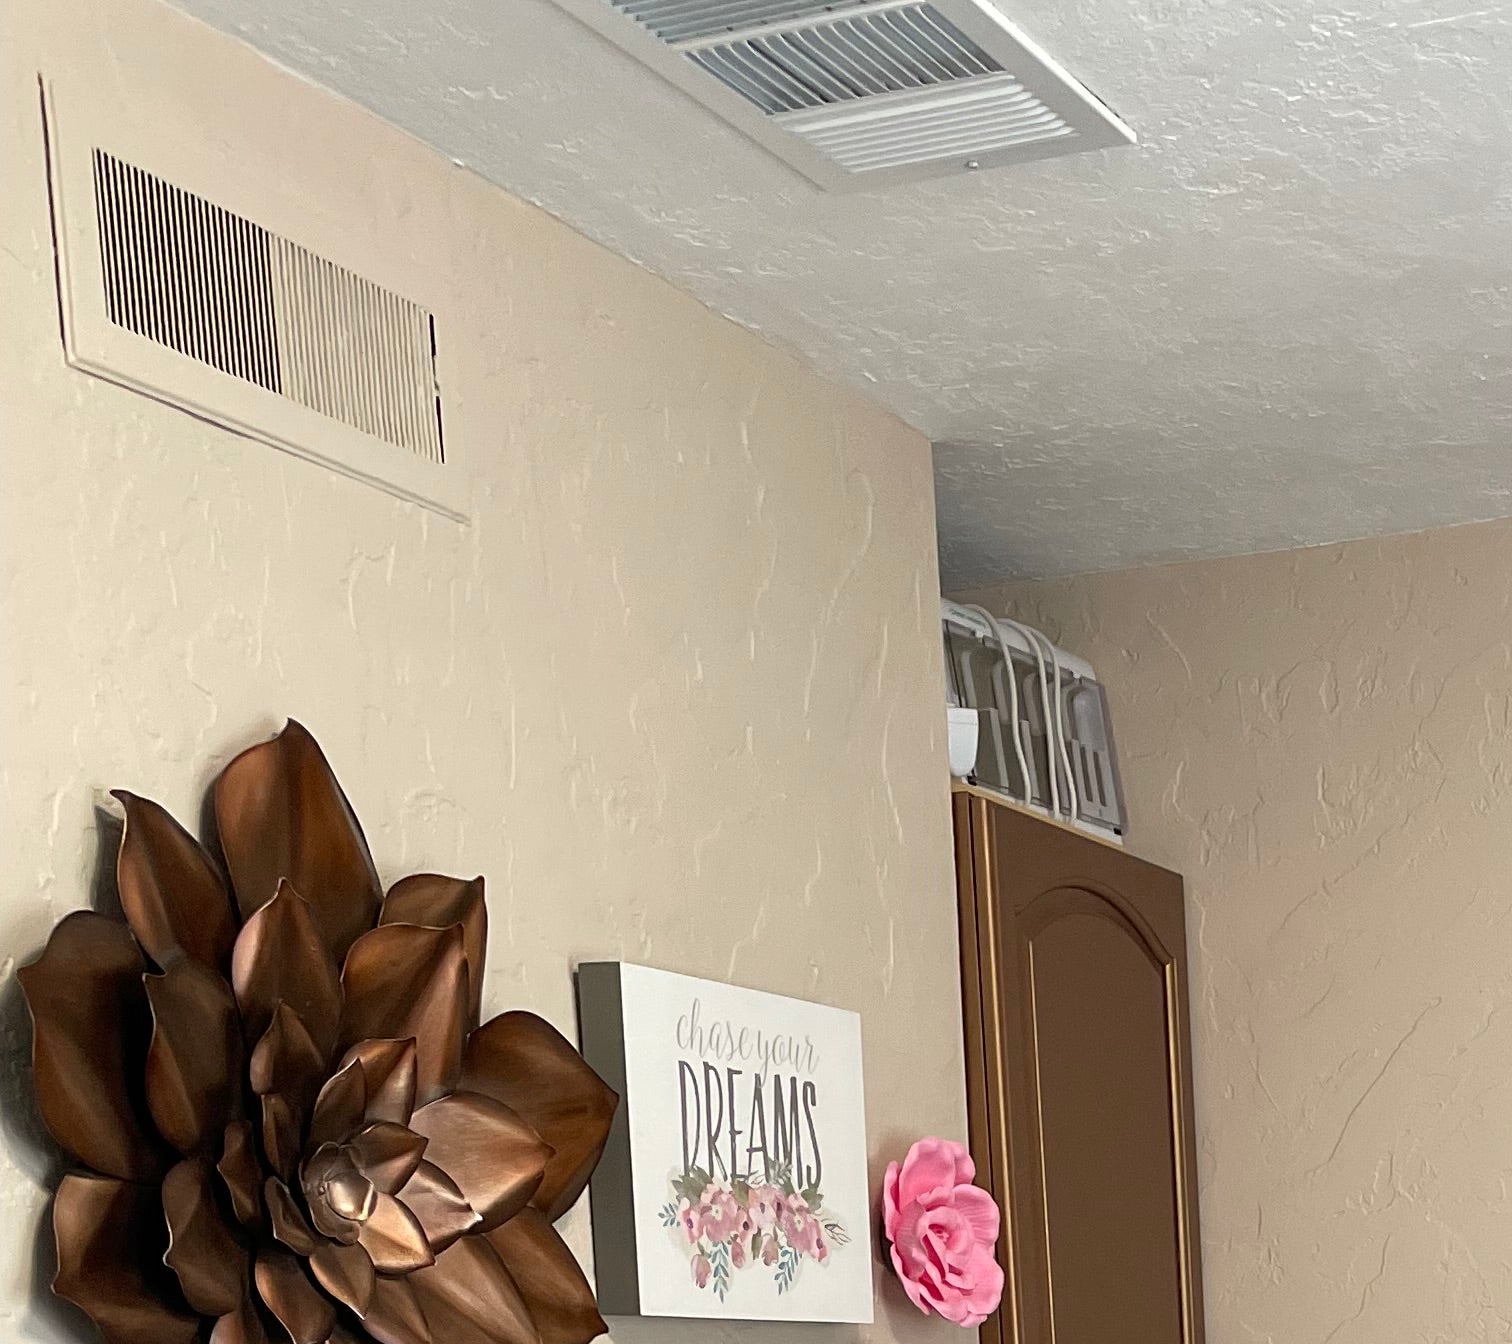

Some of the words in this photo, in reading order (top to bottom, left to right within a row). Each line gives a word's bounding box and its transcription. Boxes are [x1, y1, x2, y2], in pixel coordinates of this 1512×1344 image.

[676, 997, 753, 1062] chase
[757, 1029, 820, 1087] your
[678, 1060, 823, 1190] DREAMS
